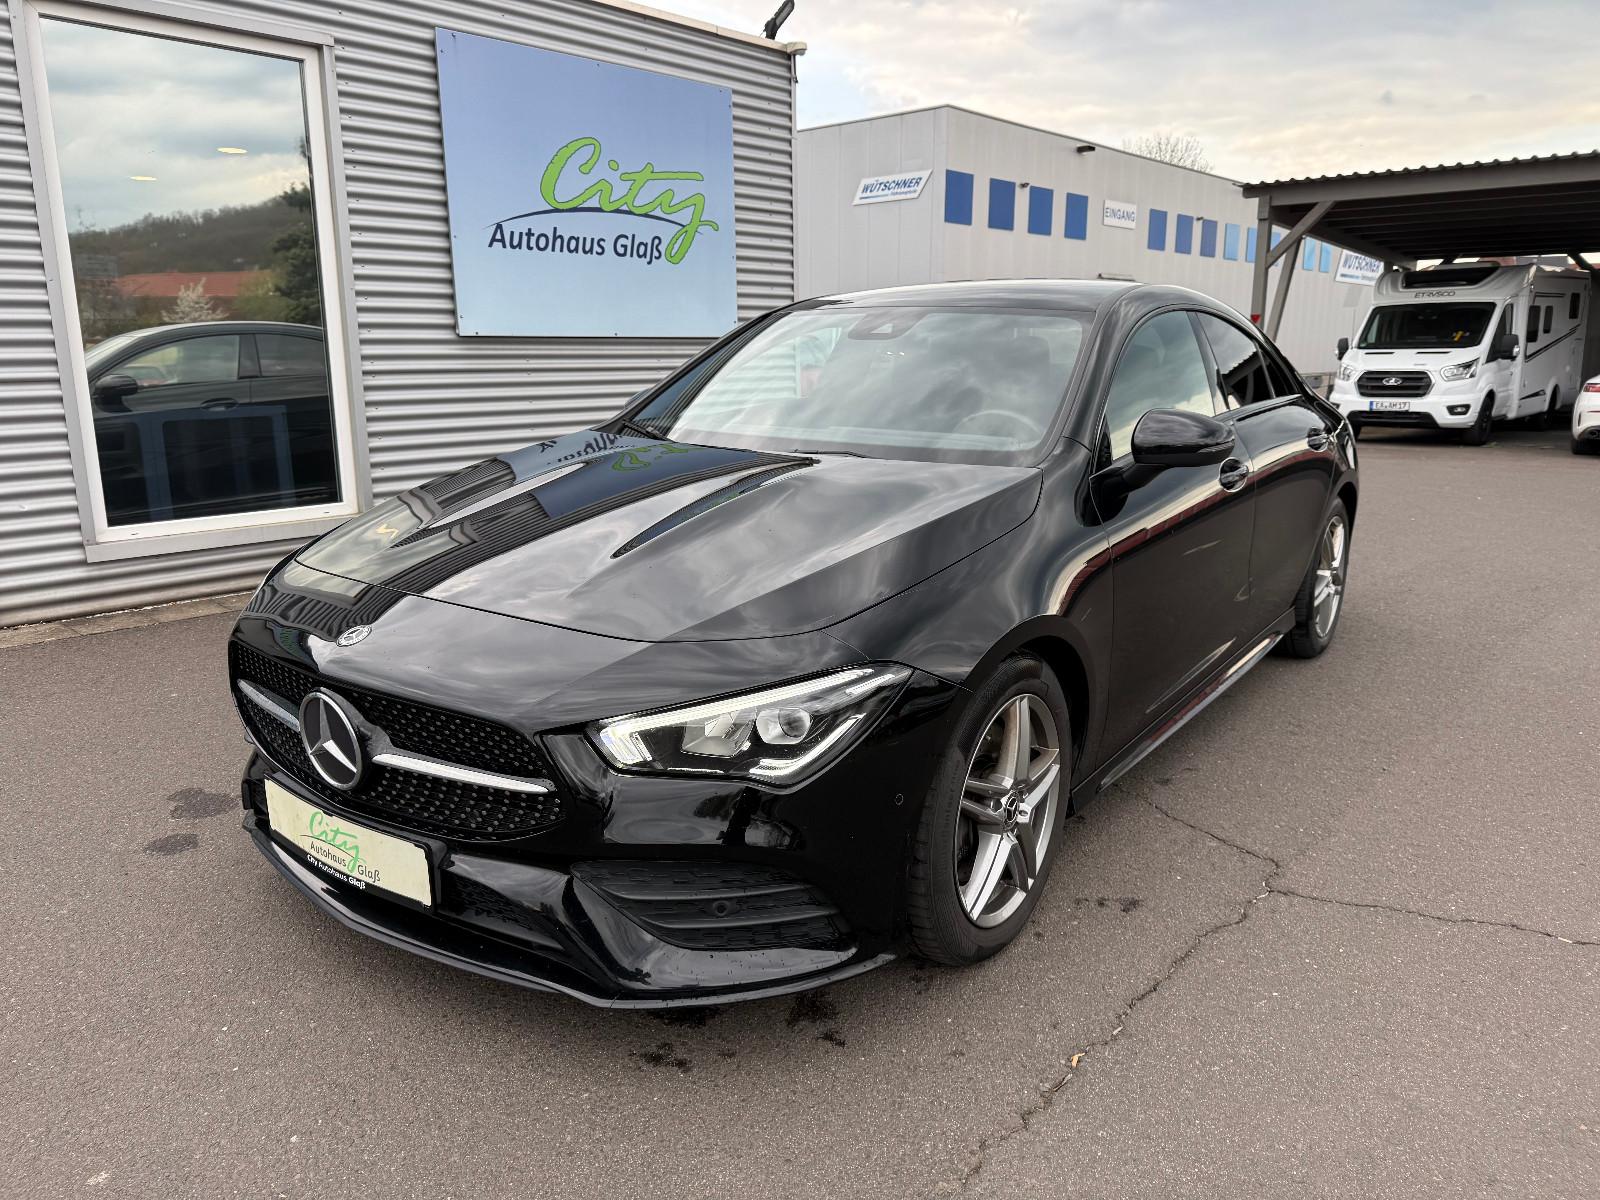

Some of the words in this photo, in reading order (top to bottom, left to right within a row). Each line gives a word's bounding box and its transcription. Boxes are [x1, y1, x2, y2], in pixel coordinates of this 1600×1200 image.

[540, 136, 719, 264] City
[1104, 207, 1136, 223] EINGANG
[488, 223, 606, 256] Autohaus
[612, 233, 663, 265] Glaß
[309, 811, 366, 873] City
[310, 841, 347, 867] Autohaus
[357, 865, 381, 883] Glaß
[307, 854, 318, 867] City
[318, 861, 348, 882] Autohaus
[348, 876, 366, 890] Glaß
